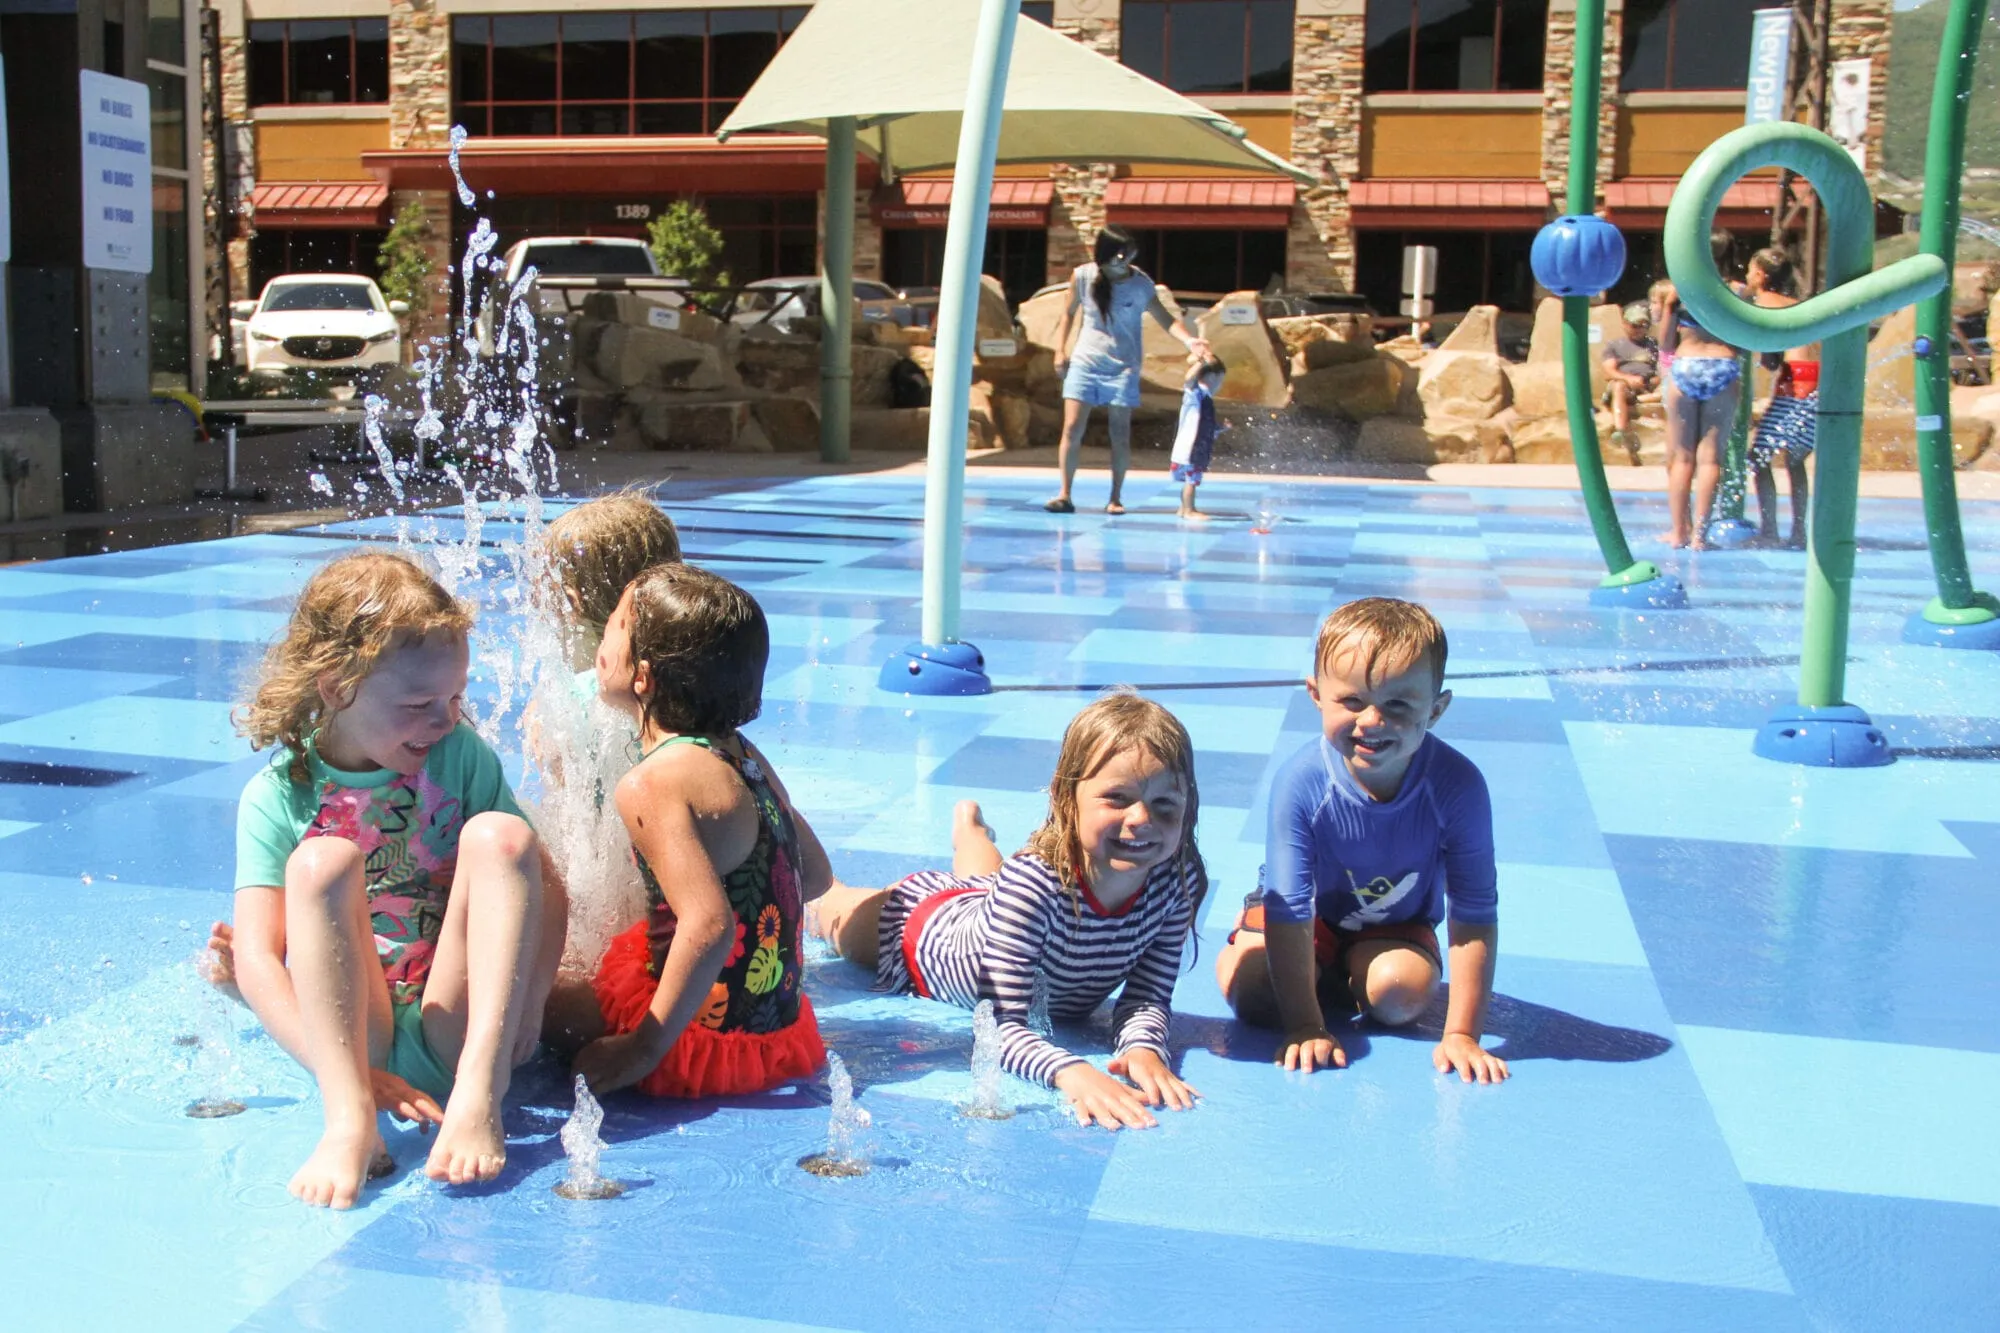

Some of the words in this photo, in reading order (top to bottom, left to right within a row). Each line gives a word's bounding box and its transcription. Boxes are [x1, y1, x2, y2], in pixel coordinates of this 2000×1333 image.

[1750, 15, 1789, 122] Newpar
[100, 98, 111, 113] NO
[615, 204, 651, 219] 1389
